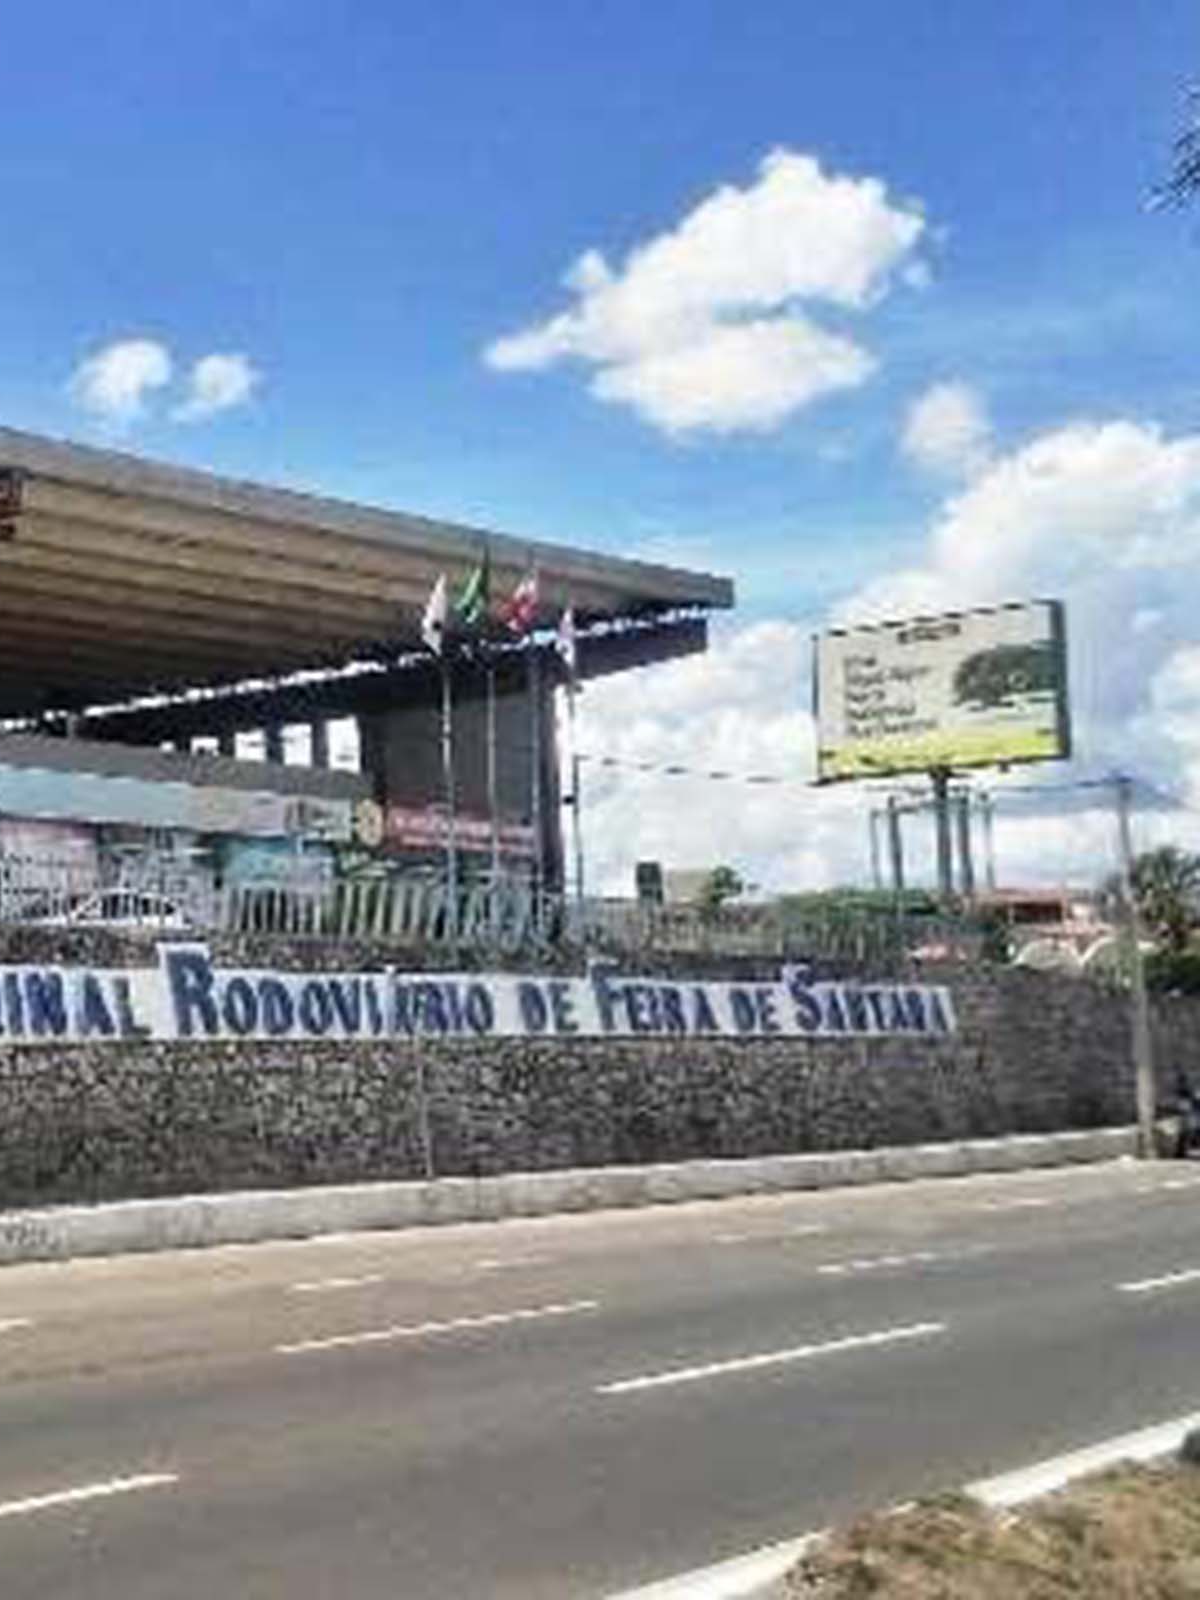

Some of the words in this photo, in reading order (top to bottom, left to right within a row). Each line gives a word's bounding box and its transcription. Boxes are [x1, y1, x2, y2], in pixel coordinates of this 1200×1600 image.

[517, 982, 579, 1032] DE
[729, 987, 782, 1032] DE
[788, 966, 950, 1032] SANTANA
